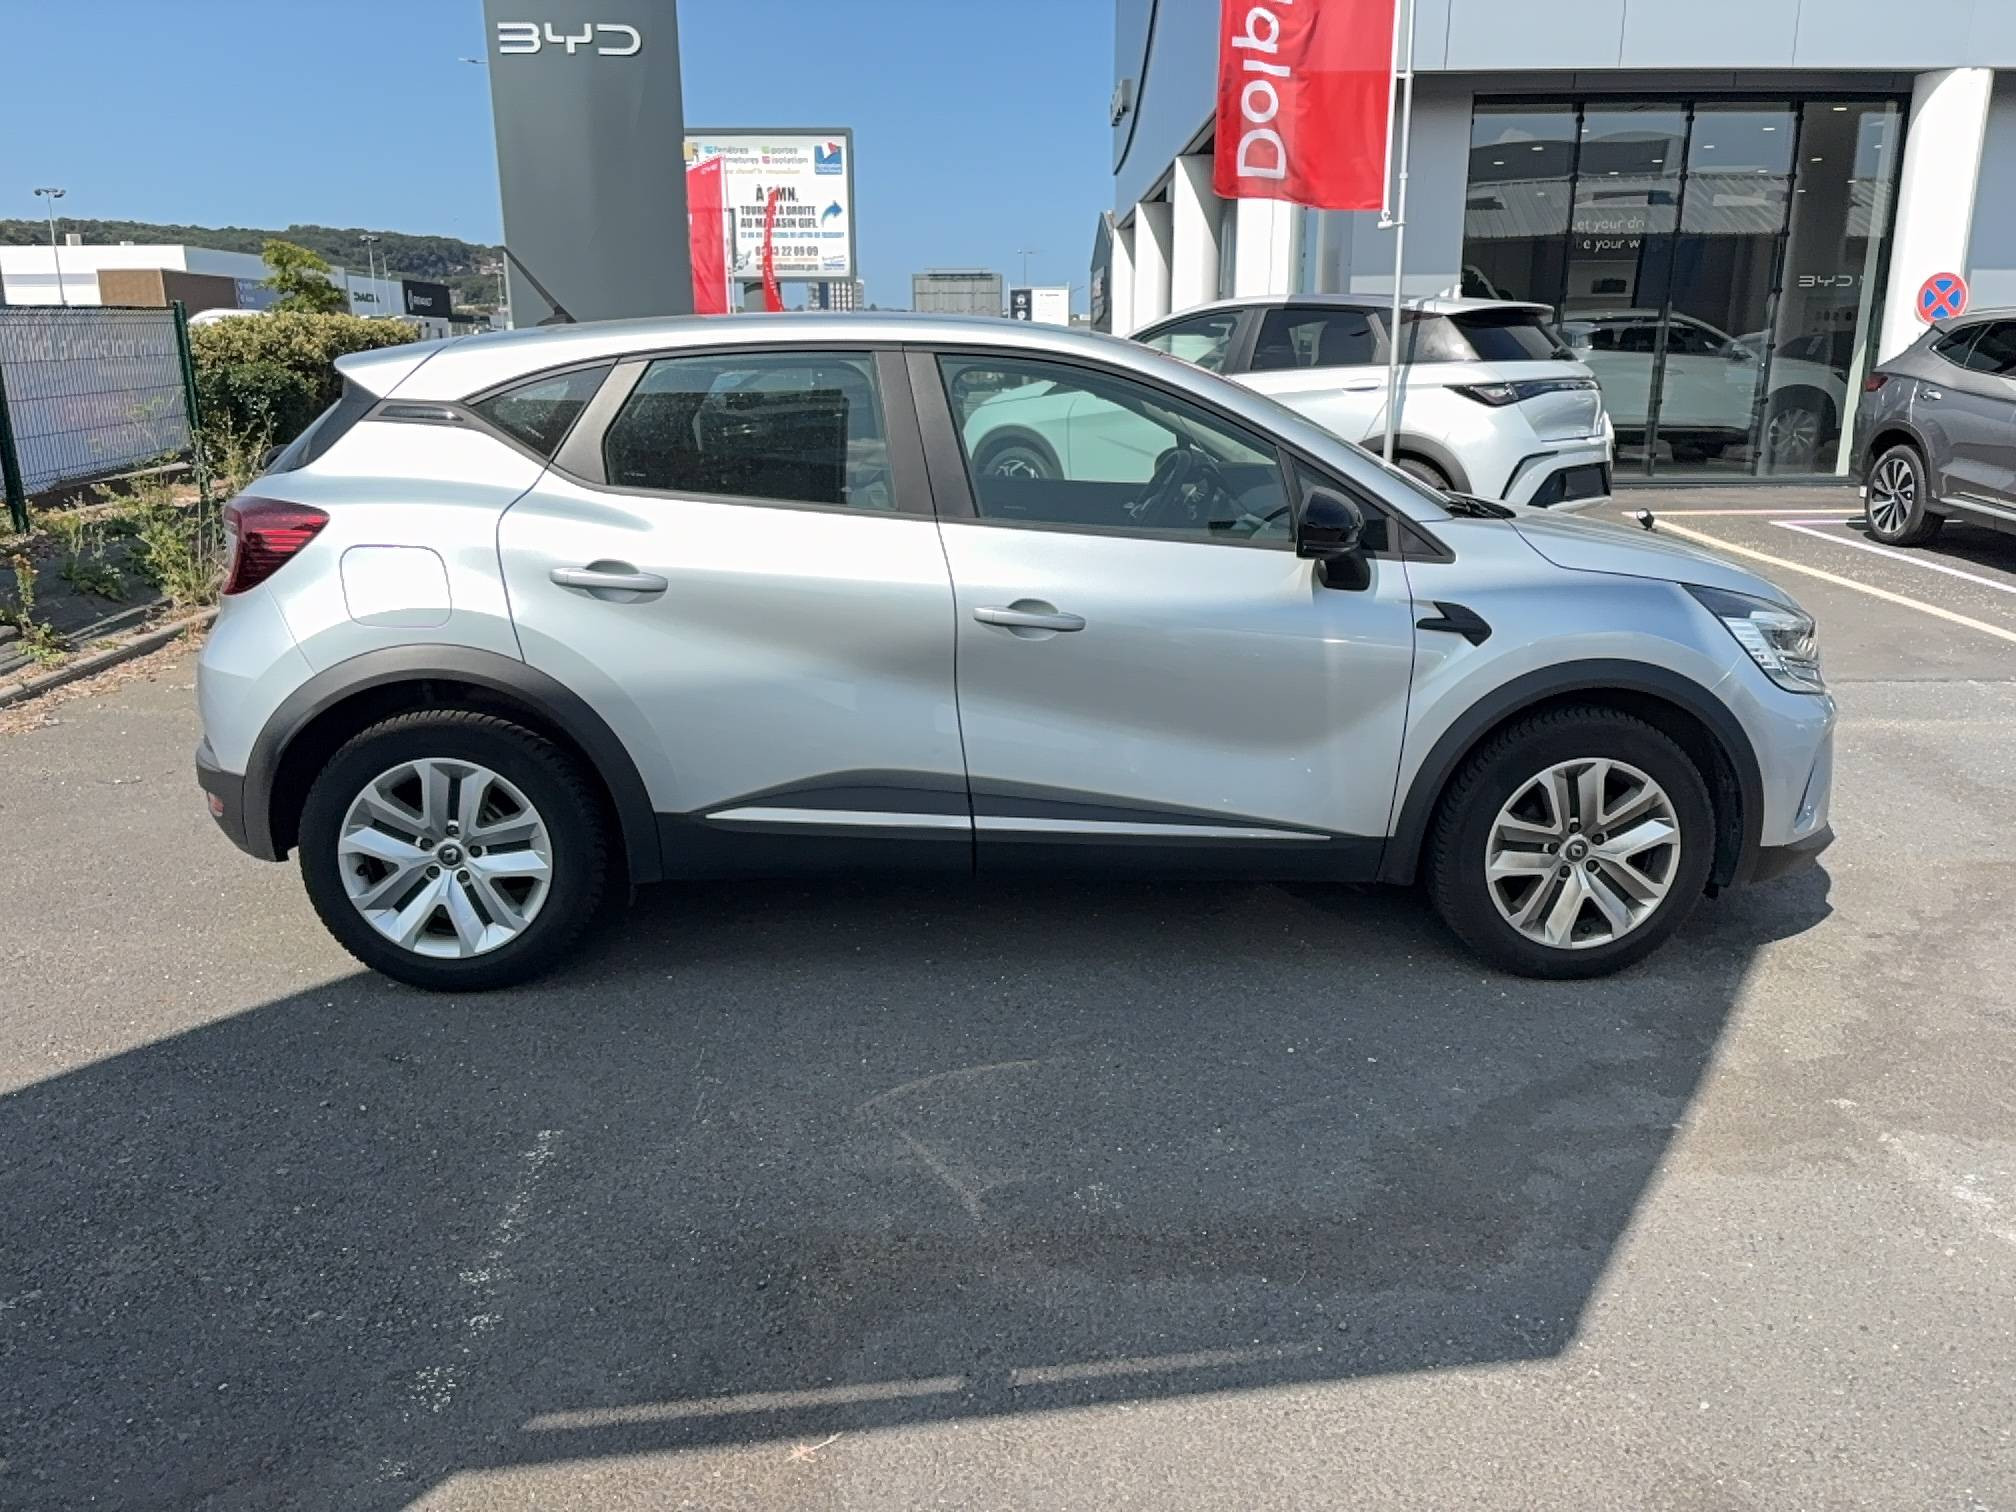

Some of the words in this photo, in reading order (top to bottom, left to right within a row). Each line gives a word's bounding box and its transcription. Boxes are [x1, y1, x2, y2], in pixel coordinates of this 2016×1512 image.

[497, 22, 642, 56] BYD
[1232, 0, 1293, 180] Dolb
[755, 184, 764, 202] À
[786, 205, 816, 216] DROITE
[740, 218, 753, 229] AU
[754, 218, 797, 229] MAASIN
[1592, 219, 1623, 233] your
[781, 245, 792, 257] 22
[807, 245, 819, 257] 09
[1594, 238, 1625, 254] your
[1798, 275, 1853, 287] BYD
